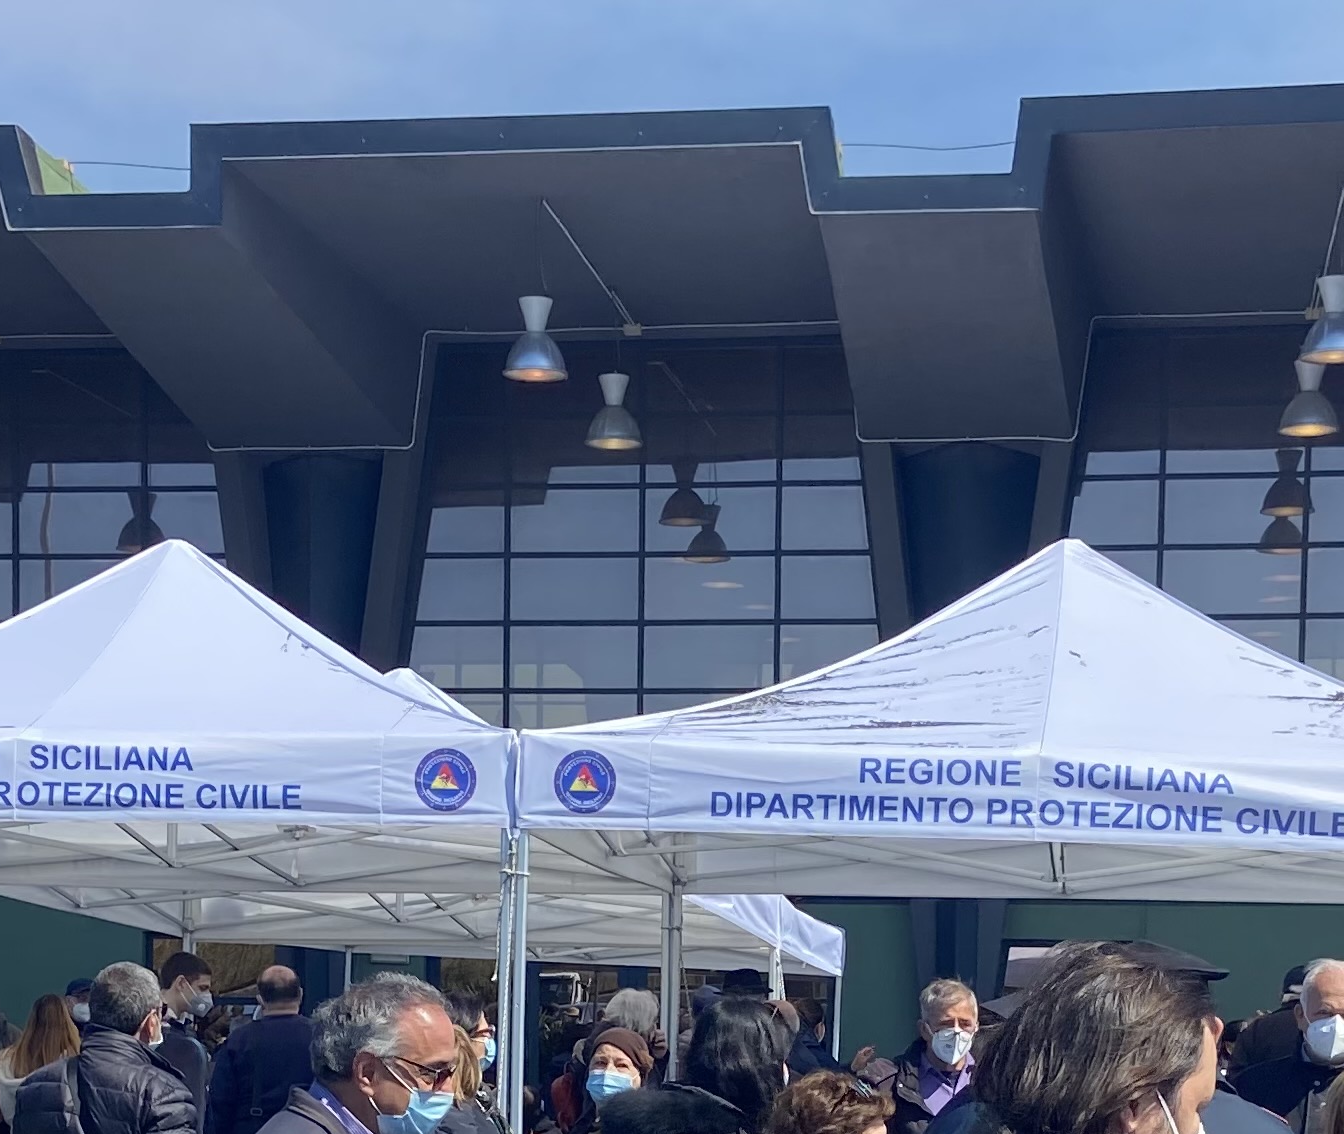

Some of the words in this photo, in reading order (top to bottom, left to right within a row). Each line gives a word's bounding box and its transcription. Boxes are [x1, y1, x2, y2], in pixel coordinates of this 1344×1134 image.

[29, 744, 194, 772] SICILIANA
[859, 757, 1022, 787] REGIONE
[1053, 761, 1235, 795] SICILIANA
[196, 783, 302, 810] CIVILE
[710, 791, 974, 824] DIPARTIMENTO
[986, 798, 1224, 833] PROTEZIONE
